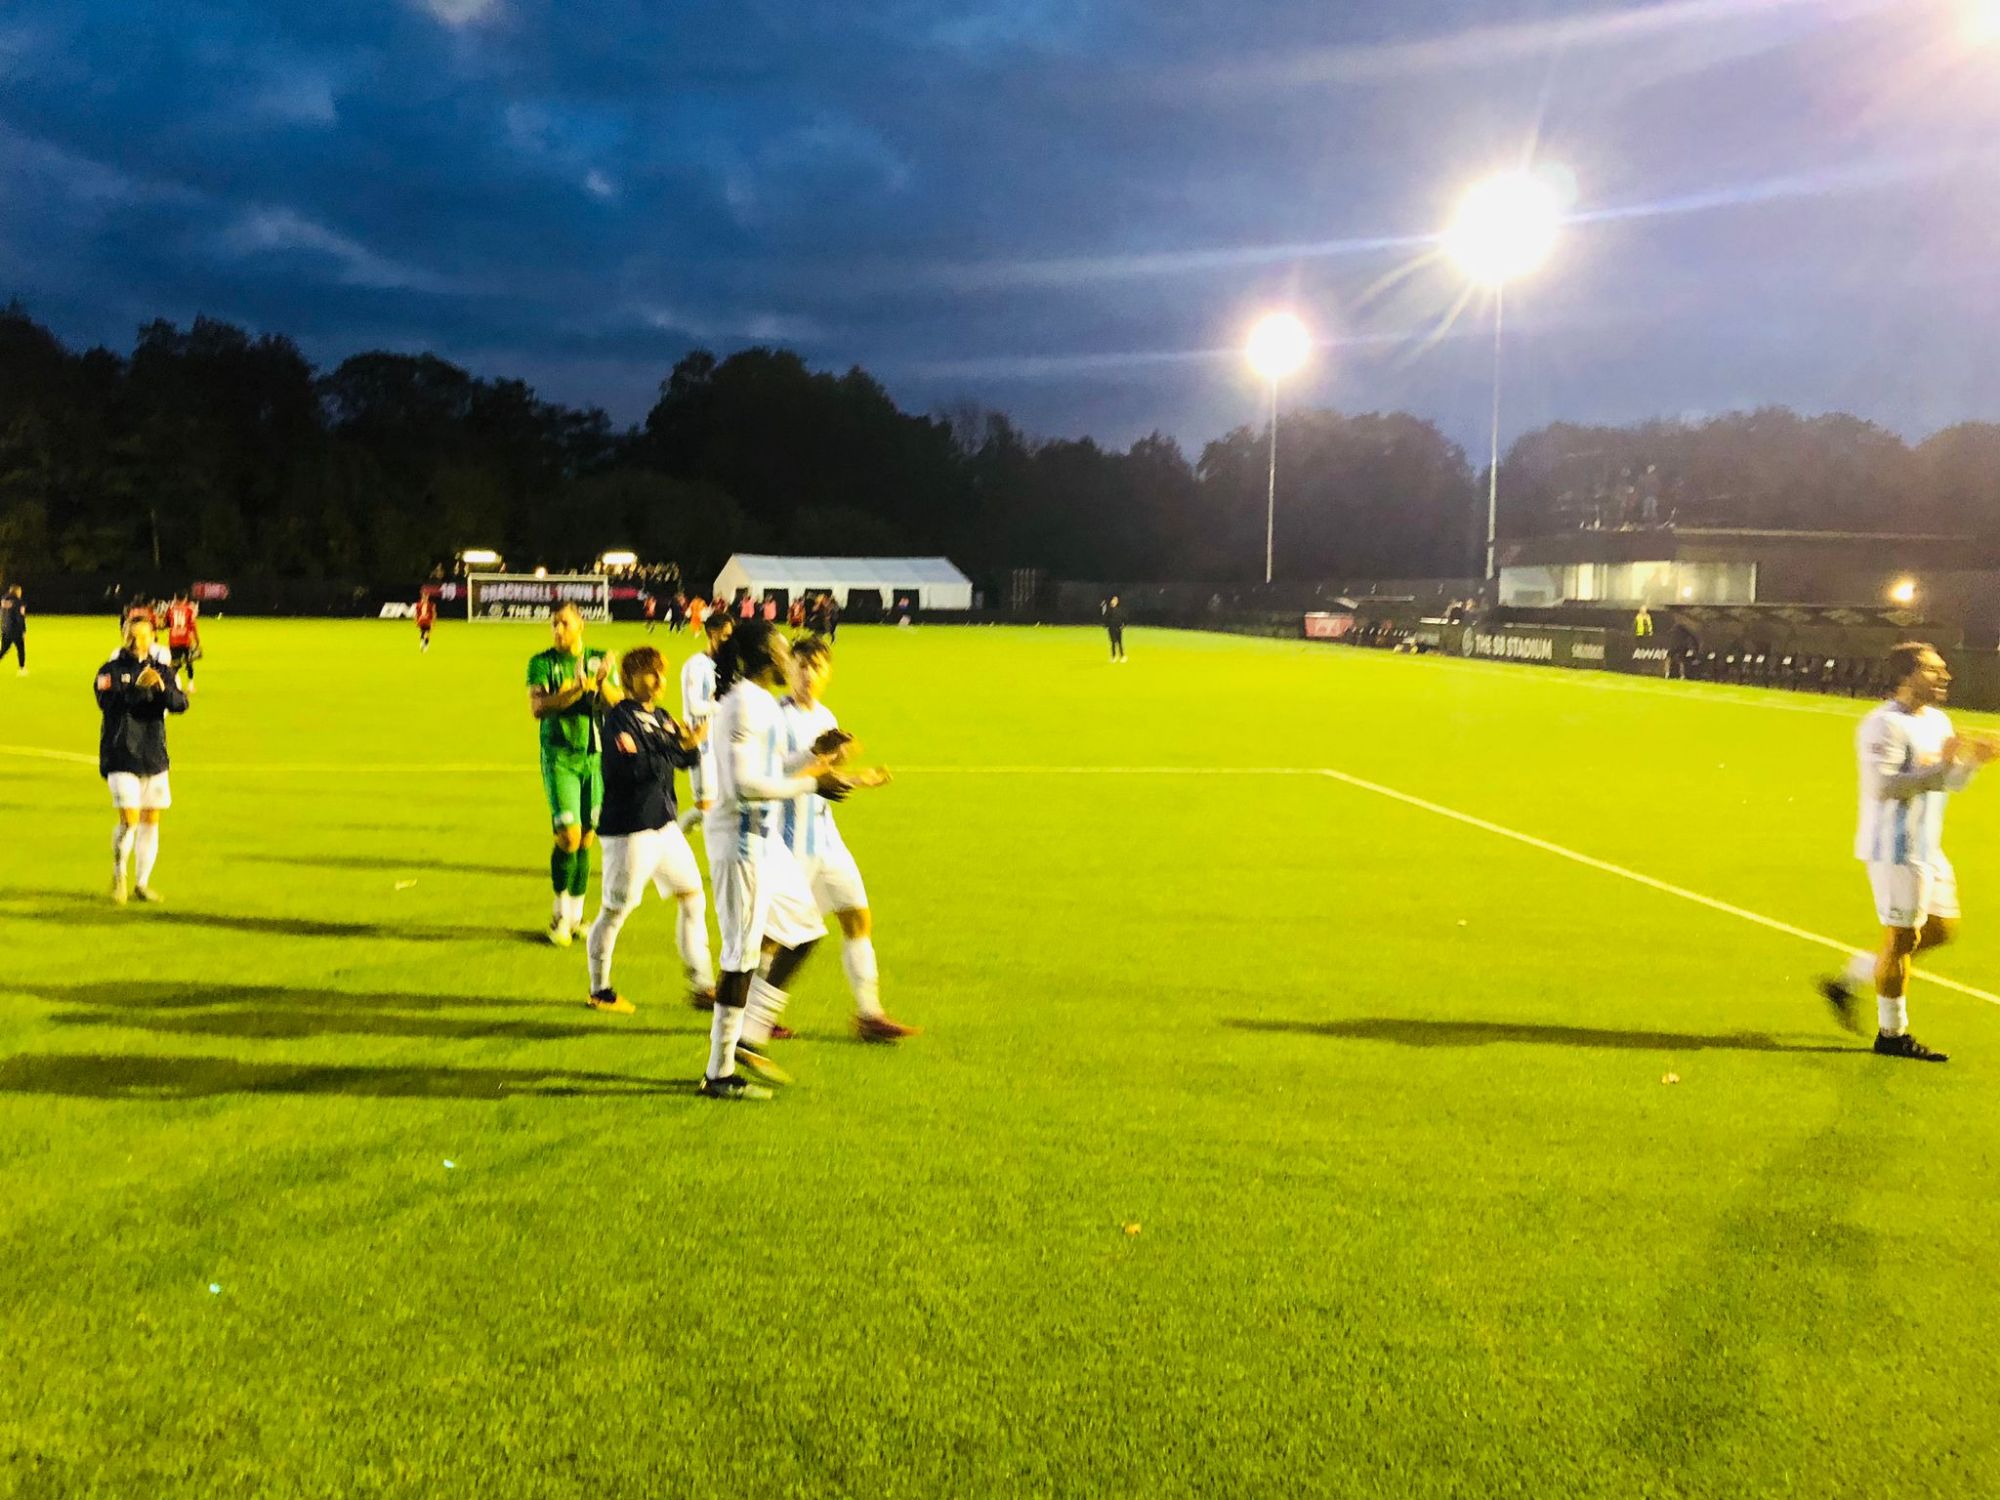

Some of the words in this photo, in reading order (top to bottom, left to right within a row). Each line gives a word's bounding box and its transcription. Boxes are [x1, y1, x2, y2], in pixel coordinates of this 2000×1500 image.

[480, 584, 552, 602] BRACKNELL
[556, 584, 593, 602] TOWN
[1475, 634, 1492, 655] THE
[1506, 636, 1552, 659] STADIUM
